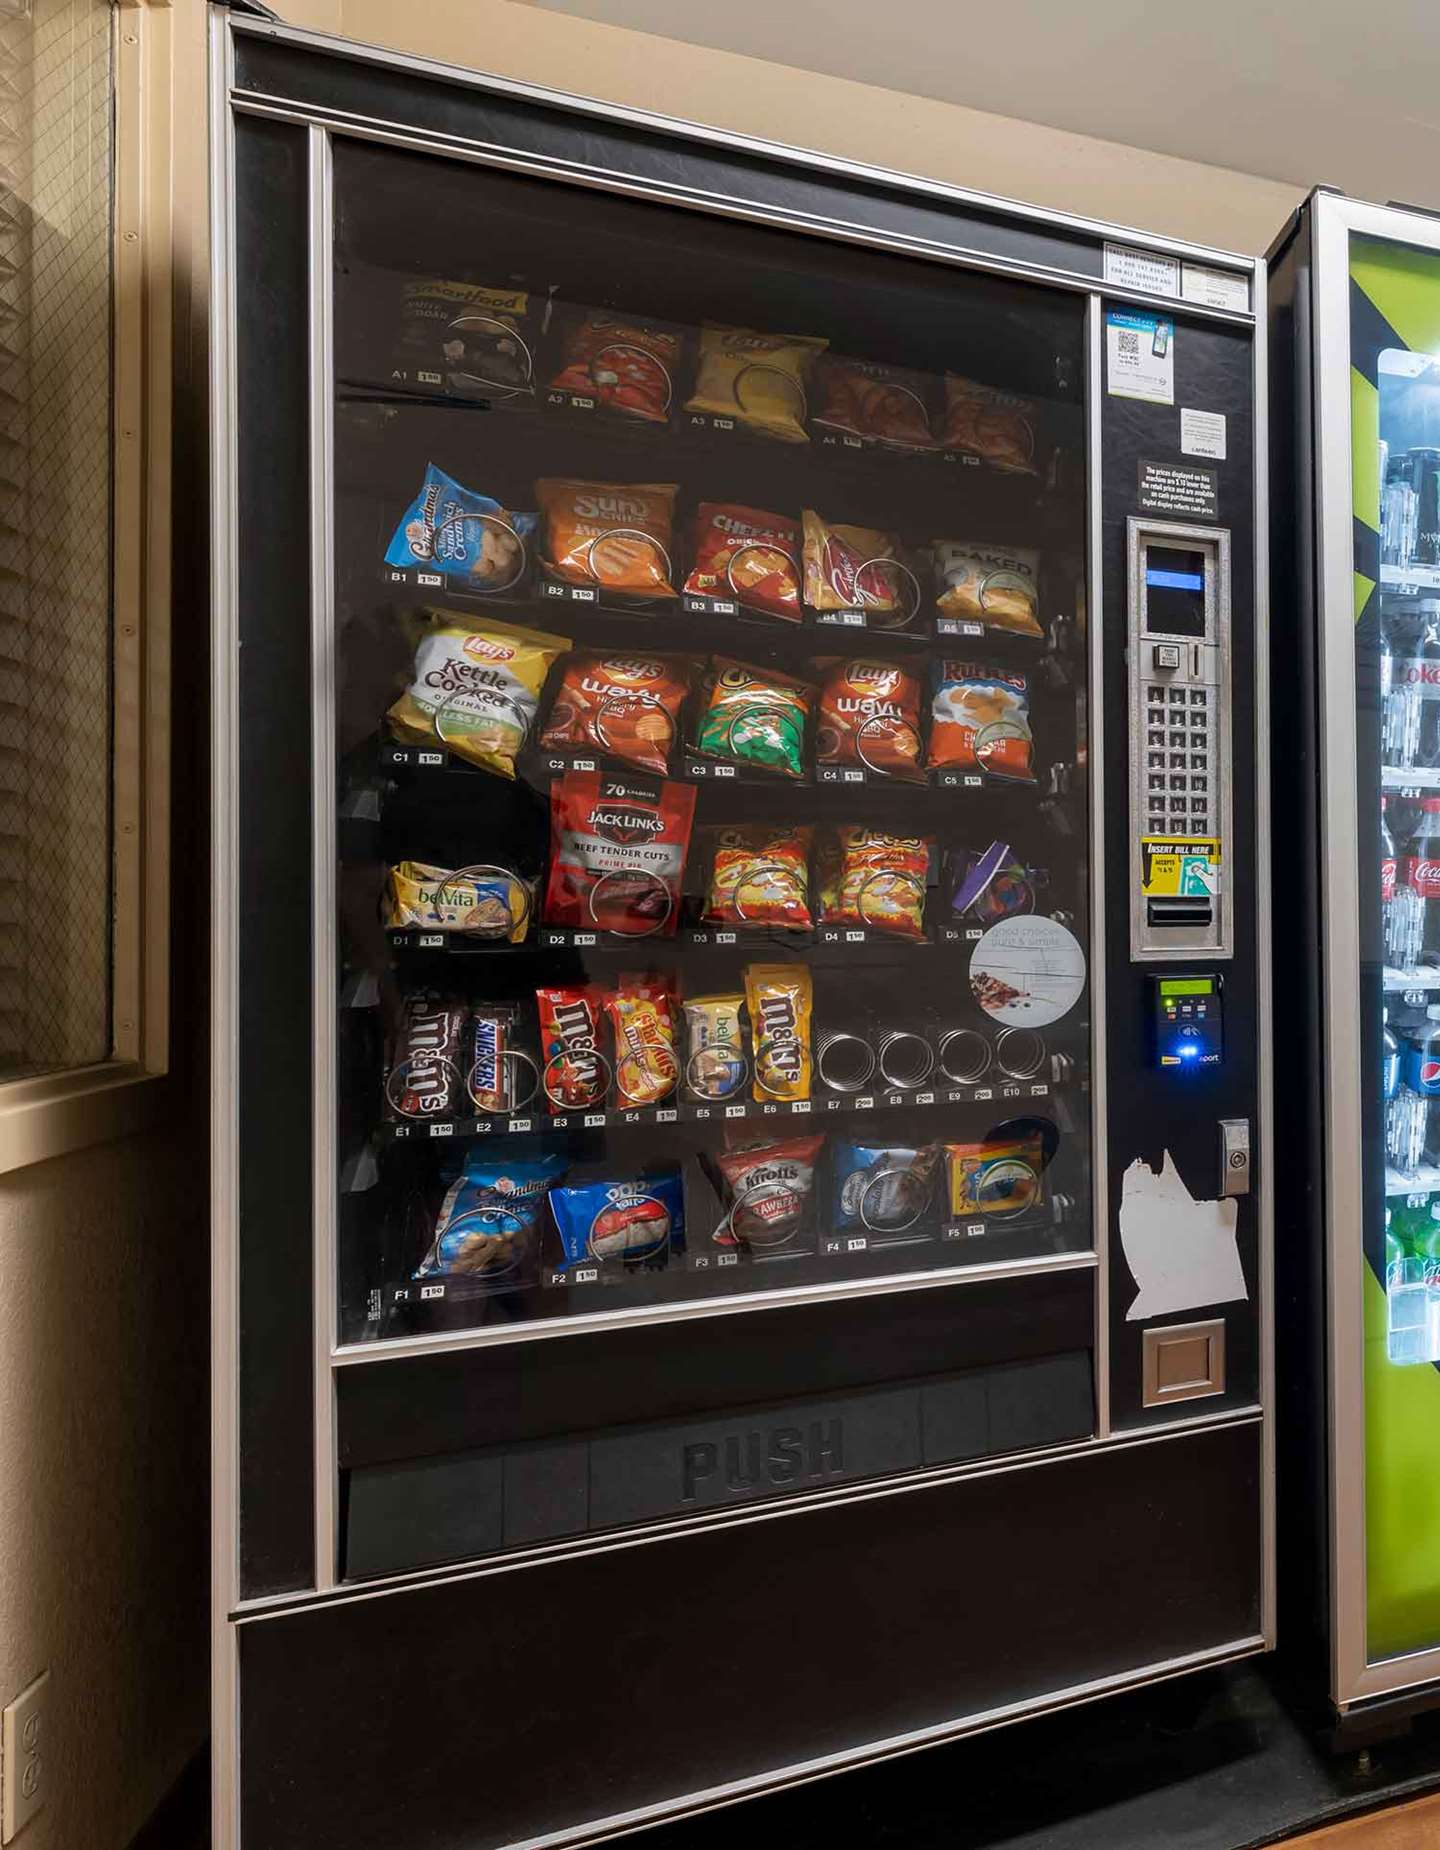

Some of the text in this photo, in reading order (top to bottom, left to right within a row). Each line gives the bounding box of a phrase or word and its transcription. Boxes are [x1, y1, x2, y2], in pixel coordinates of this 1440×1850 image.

[1156, 469, 1171, 478] prices
[1172, 470, 1194, 481] displayed
[1142, 498, 1157, 507] Digital
[1158, 500, 1173, 509] display
[391, 573, 406, 582] B1
[548, 586, 563, 596] B2
[691, 601, 705, 611] B3
[440, 658, 507, 690] Kettle
[425, 671, 506, 707] Cooked
[393, 753, 408, 762] C1
[549, 760, 564, 769] C2
[692, 767, 706, 775] C3
[823, 772, 837, 780] C4
[945, 776, 957, 785] C5
[606, 783, 626, 796] 70
[586, 811, 622, 828] JACK
[574, 843, 670, 862] BEEF TENDER CUTS
[1147, 843, 1173, 854] INSERT
[393, 936, 408, 945] D1
[550, 936, 564, 945] D2
[693, 934, 707, 942] D3
[825, 933, 838, 941] D4
[475, 1018, 497, 1092] SNICKERS
[1004, 1088, 1020, 1096] E10
[890, 1096, 902, 1104] E8
[764, 1104, 777, 1113] E6
[828, 1101, 840, 1109] E7
[625, 1114, 640, 1122] E4
[697, 1109, 710, 1118] E5
[554, 1118, 568, 1127] E3
[396, 1127, 410, 1136] E1
[476, 1123, 492, 1132] E2
[827, 1243, 839, 1252] F4
[696, 1258, 708, 1267] F3
[552, 1275, 566, 1284] F2
[395, 1290, 409, 1300] F1
[681, 1419, 845, 1502] PUSH
